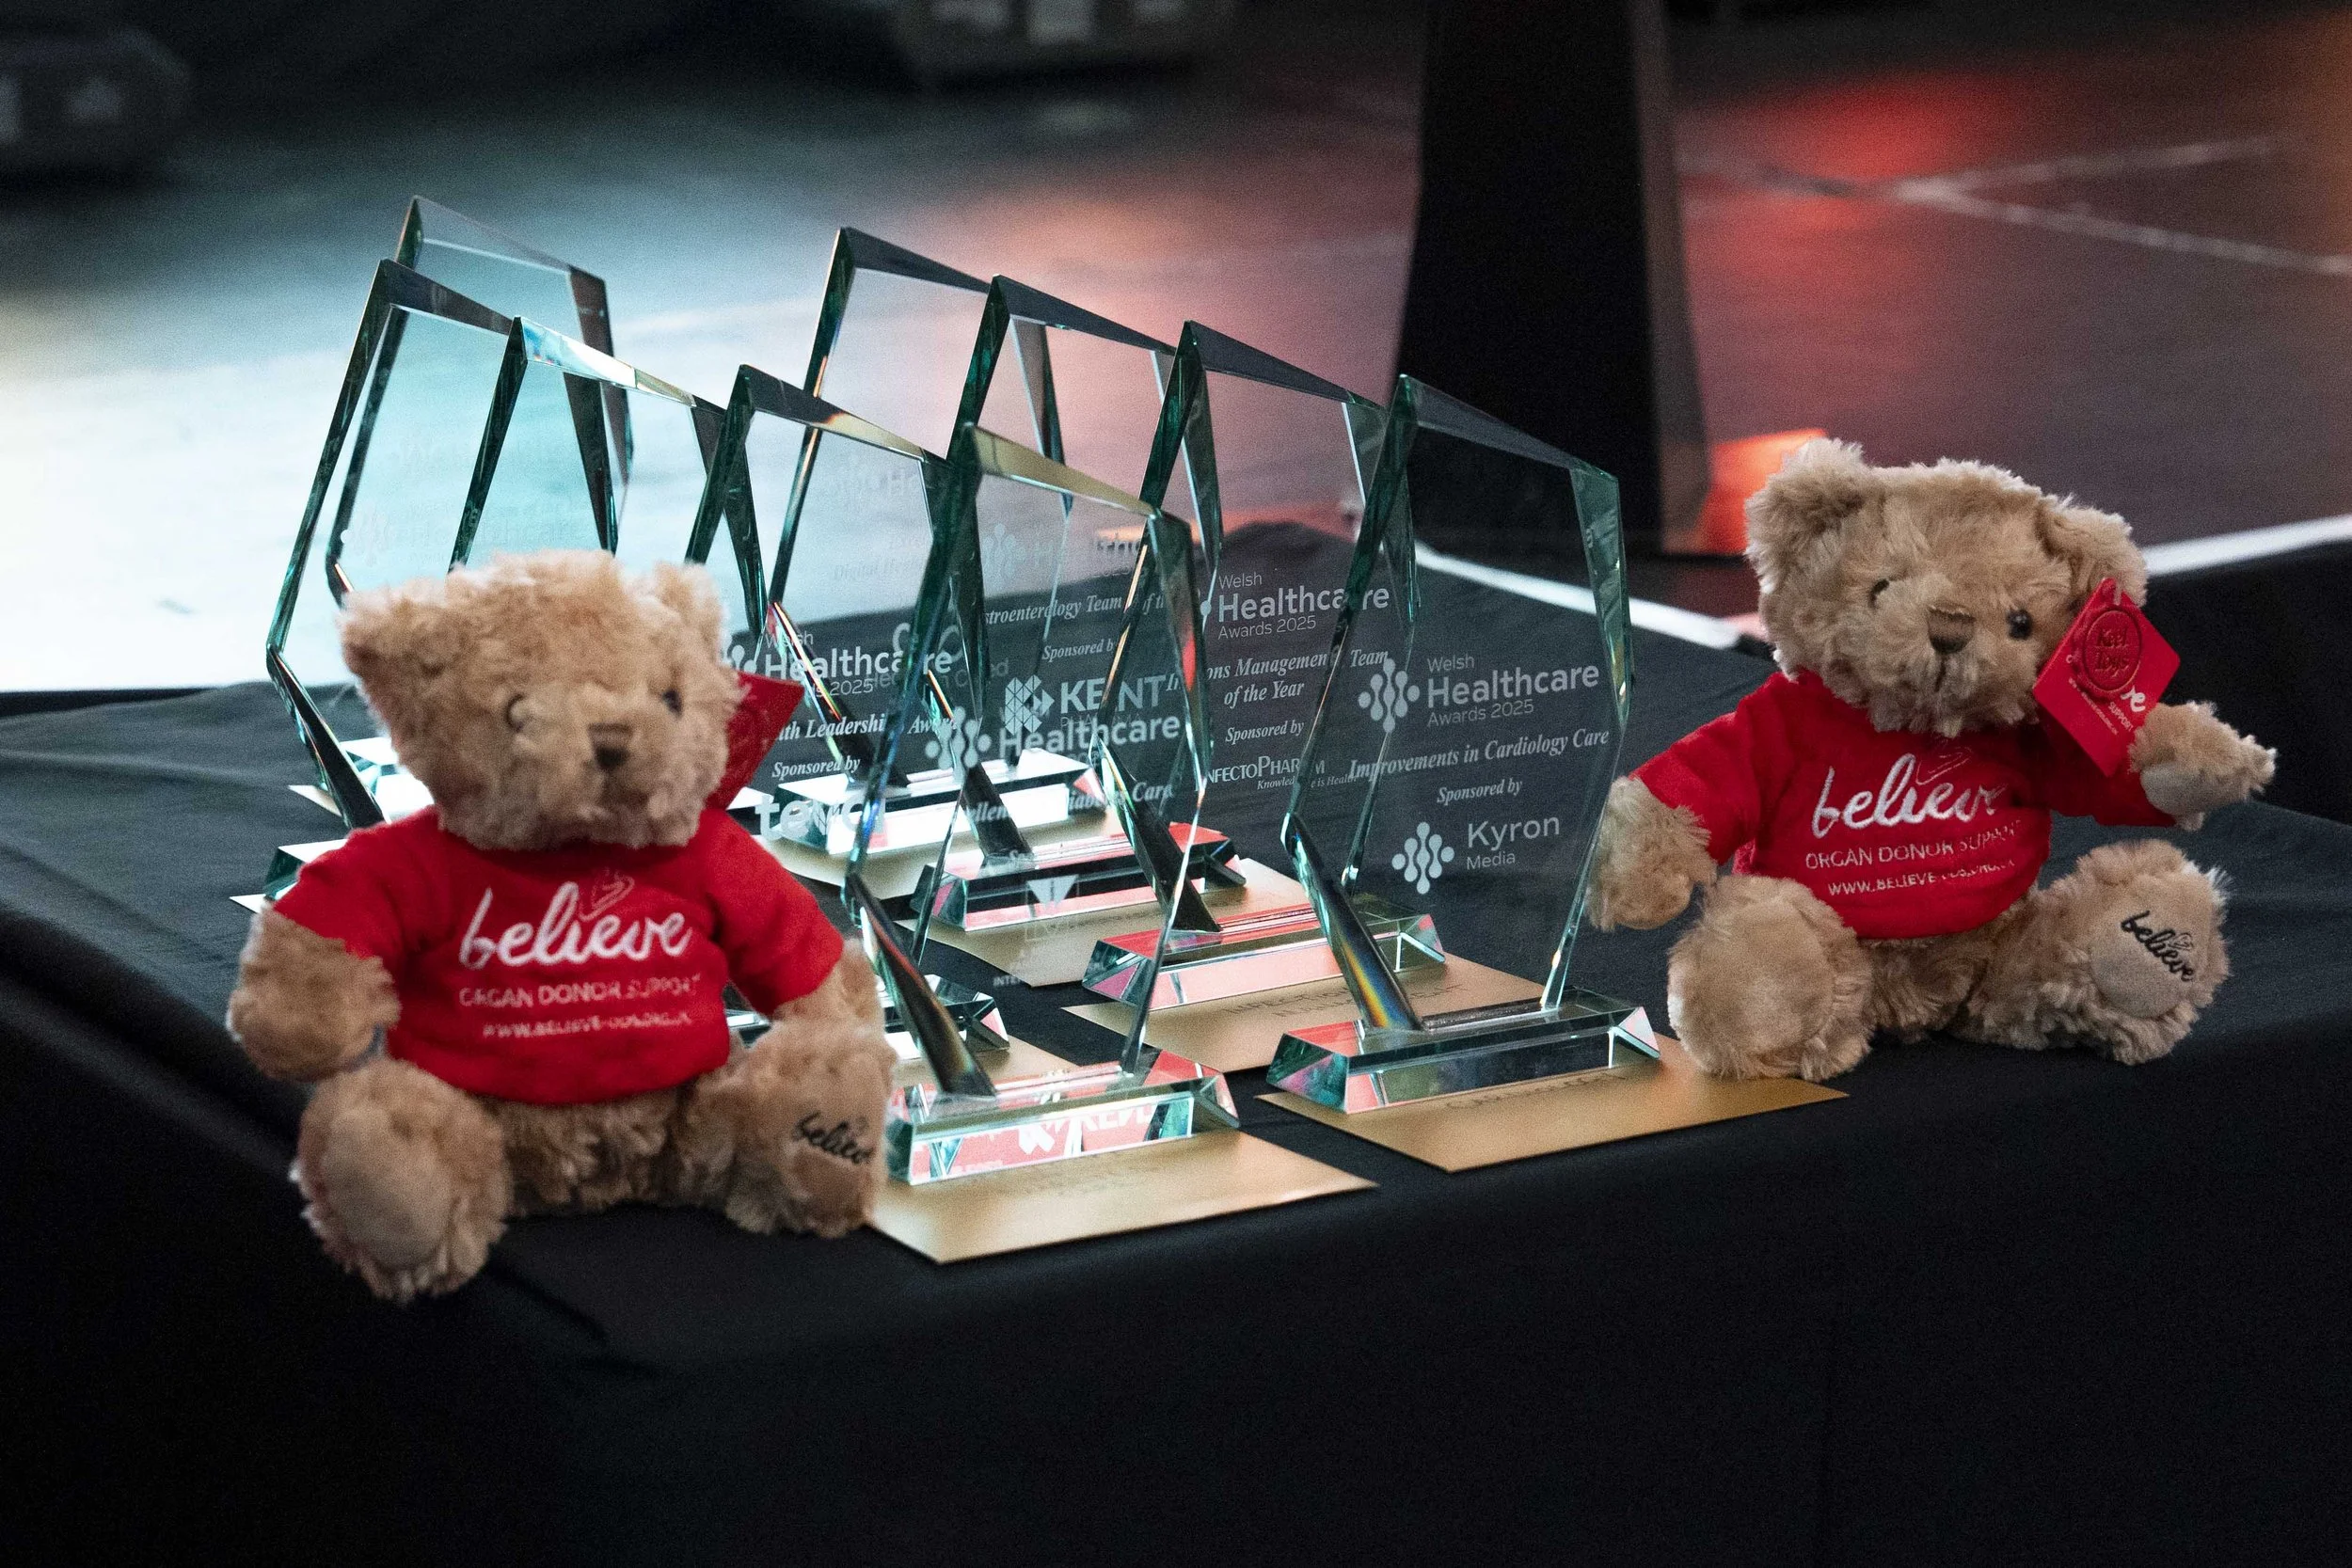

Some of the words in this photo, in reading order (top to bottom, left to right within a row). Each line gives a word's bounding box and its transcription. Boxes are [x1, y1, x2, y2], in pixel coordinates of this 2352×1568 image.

[1218, 571, 1263, 591] Welsh
[1086, 594, 1123, 613] Team
[1217, 620, 1273, 641] Awards
[1276, 614, 1317, 634] 2025
[1041, 640, 1104, 663] Sponsored
[1234, 651, 1329, 678] Managemen
[1349, 649, 1390, 668] Team
[1426, 653, 1475, 674] Welsh
[830, 678, 875, 696] 2025
[1060, 673, 1168, 714] KENT
[1224, 688, 1242, 709] of
[1244, 683, 1266, 702] the
[1271, 680, 1305, 700] Year
[1427, 663, 1599, 708] Healthcare
[804, 712, 886, 739] Leadershi
[1427, 705, 1486, 728] Awards
[1490, 699, 1534, 720] 2025
[999, 715, 1182, 758] Healthcare
[1225, 721, 1288, 746] Sponsored
[1290, 719, 1305, 737] by
[771, 758, 841, 782] Sponsored
[844, 755, 861, 773] by
[1349, 748, 1460, 781] Improvements
[1463, 744, 1480, 764] in
[1485, 731, 1570, 762] Cardiology
[1572, 727, 1610, 749] Care
[1437, 782, 1503, 808] Sponsored
[1506, 777, 1523, 799] by
[1812, 753, 2010, 839] believ
[1467, 816, 1561, 852] Kyron
[1466, 851, 1517, 872] Media
[1805, 847, 1873, 870] ORGAN
[459, 880, 694, 971] believe
[2121, 909, 2195, 982] believe
